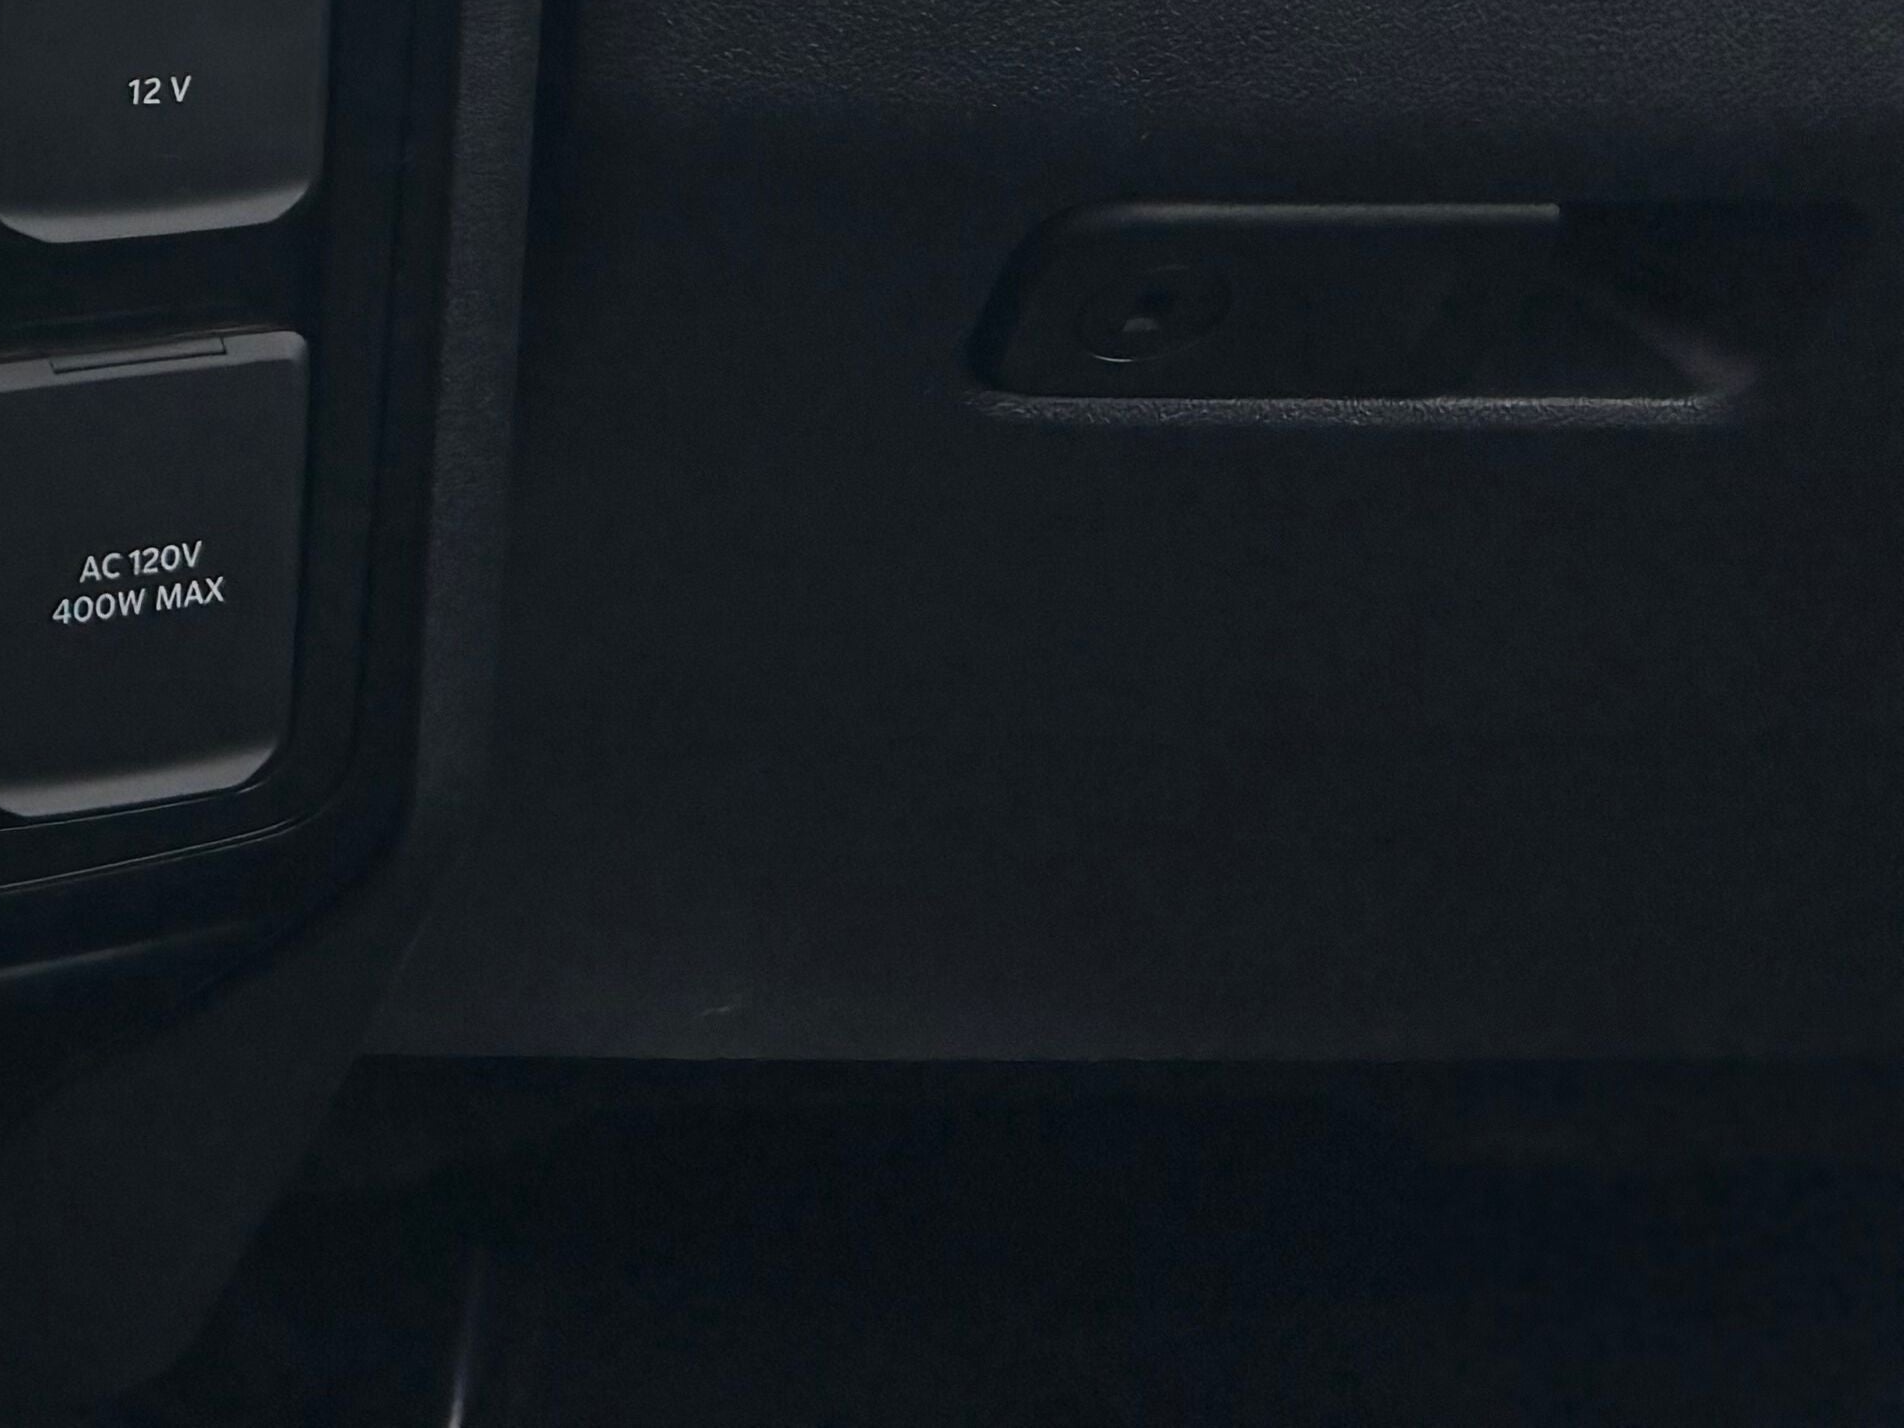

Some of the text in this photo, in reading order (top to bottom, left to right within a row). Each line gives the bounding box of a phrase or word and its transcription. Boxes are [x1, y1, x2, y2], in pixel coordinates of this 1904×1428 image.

[128, 75, 192, 105] 12 V
[79, 541, 203, 583] AC 120V
[52, 578, 225, 625] 400W MAX
